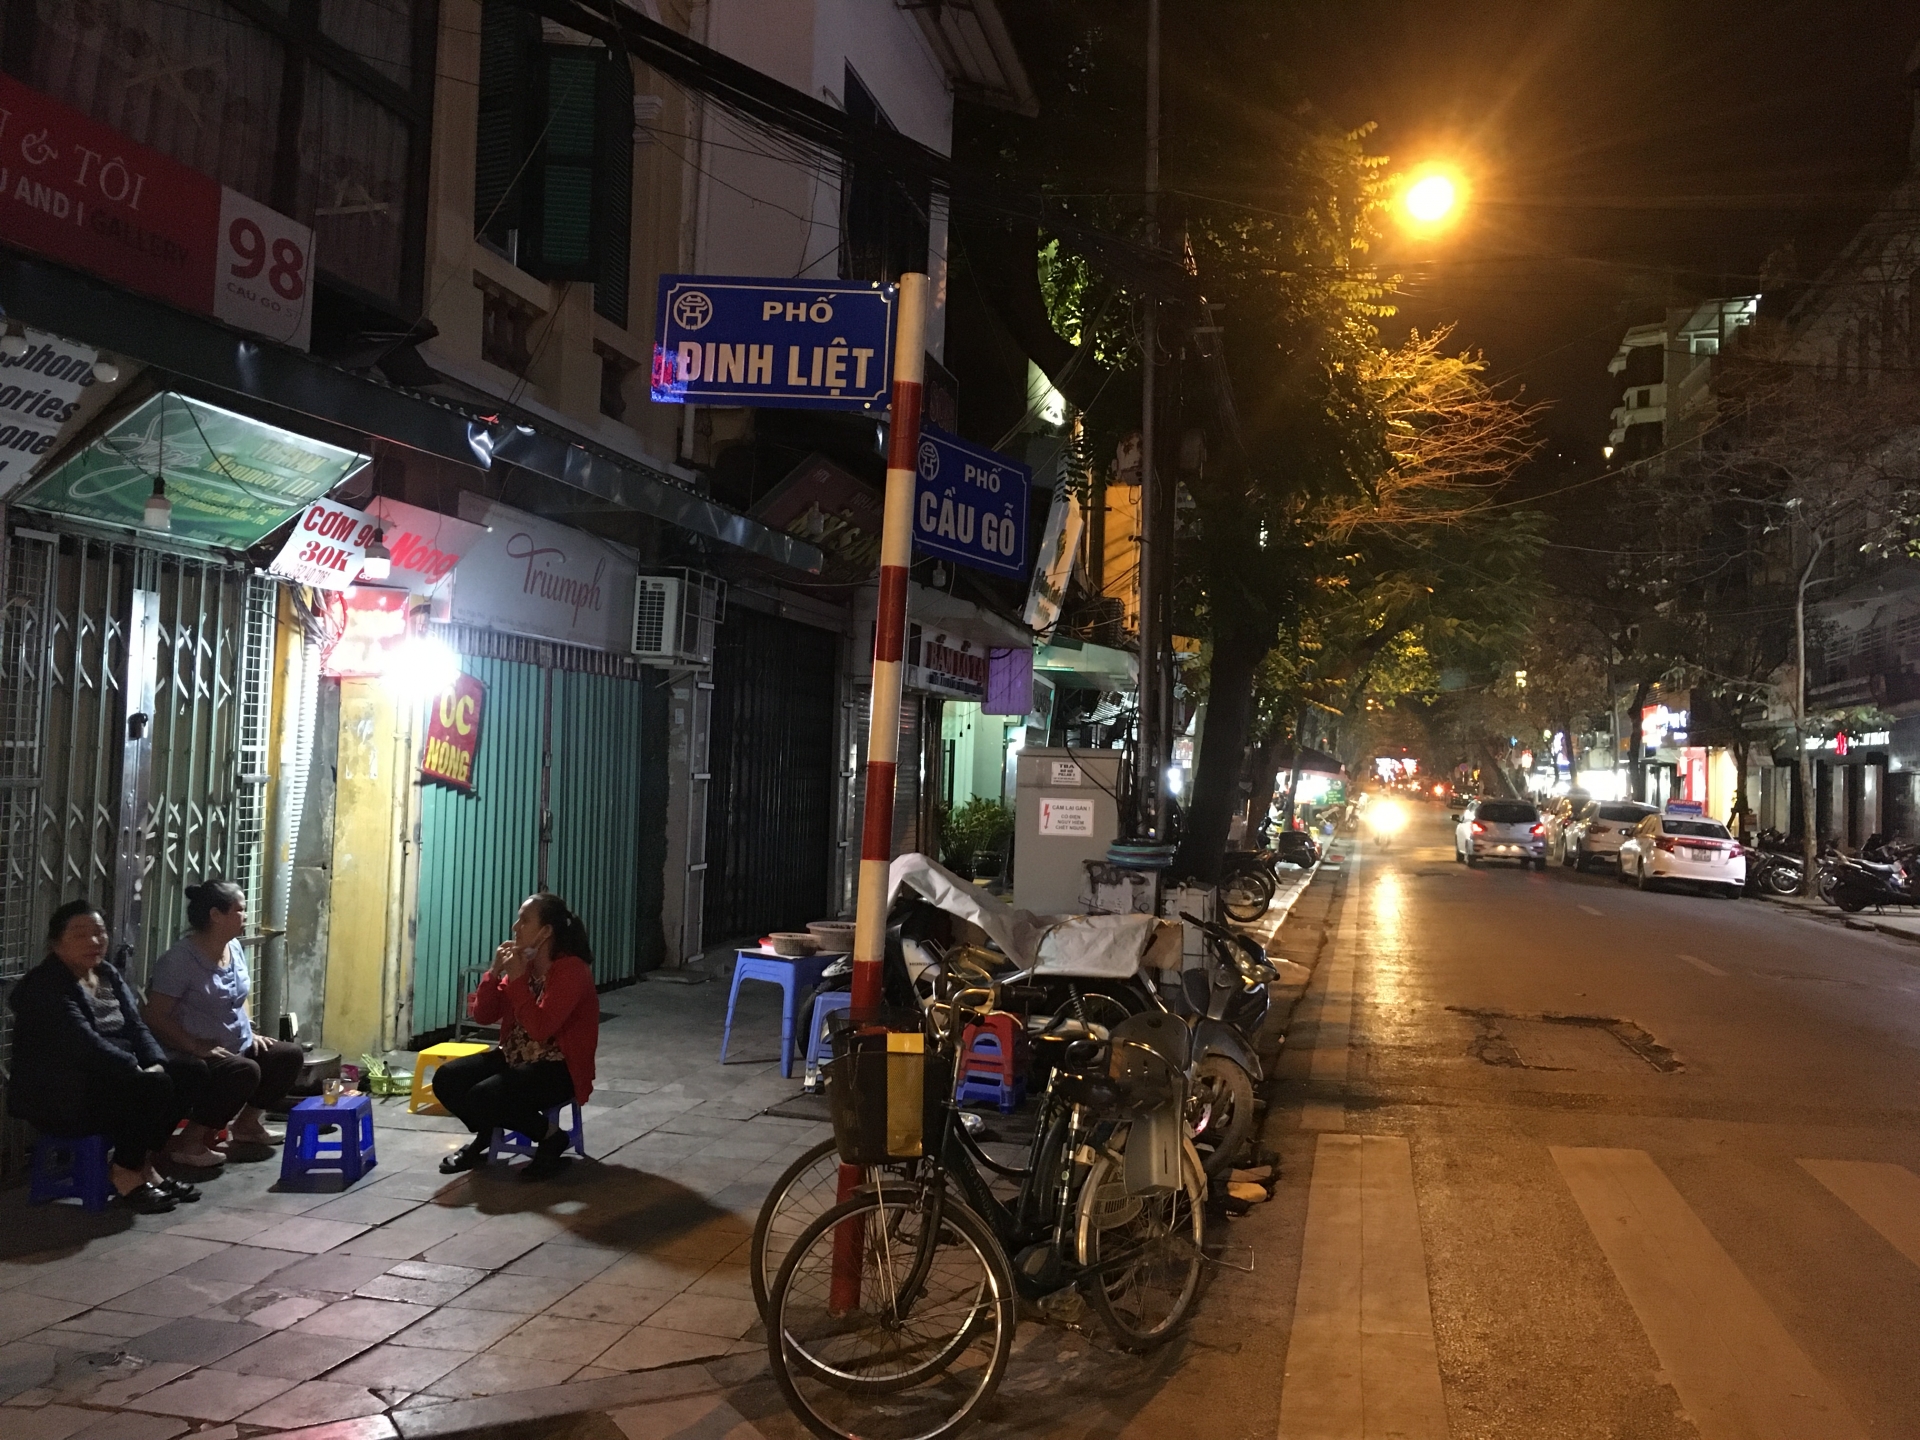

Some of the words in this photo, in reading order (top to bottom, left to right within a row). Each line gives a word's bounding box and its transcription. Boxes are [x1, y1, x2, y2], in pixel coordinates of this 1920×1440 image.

[21, 127, 59, 165] &
[73, 143, 148, 211] TÔI
[14, 175, 70, 219] AND
[77, 200, 84, 227] I
[228, 217, 304, 301] 98
[226, 282, 256, 302] CAU
[260, 297, 281, 312] GO
[762, 294, 837, 323] PHỐ
[677, 341, 774, 385] ĐINH
[787, 337, 874, 396] LIỆT
[0, 383, 81, 423] ories
[0, 424, 57, 455] one
[964, 463, 1003, 494] PHỐ
[303, 505, 359, 543] CƠM
[919, 486, 976, 545] CẦU
[981, 502, 1016, 557] GỖ
[298, 540, 355, 573] 30K
[388, 531, 460, 585] Nóng
[506, 532, 606, 628] Triumph
[425, 735, 471, 782] NÓNG
